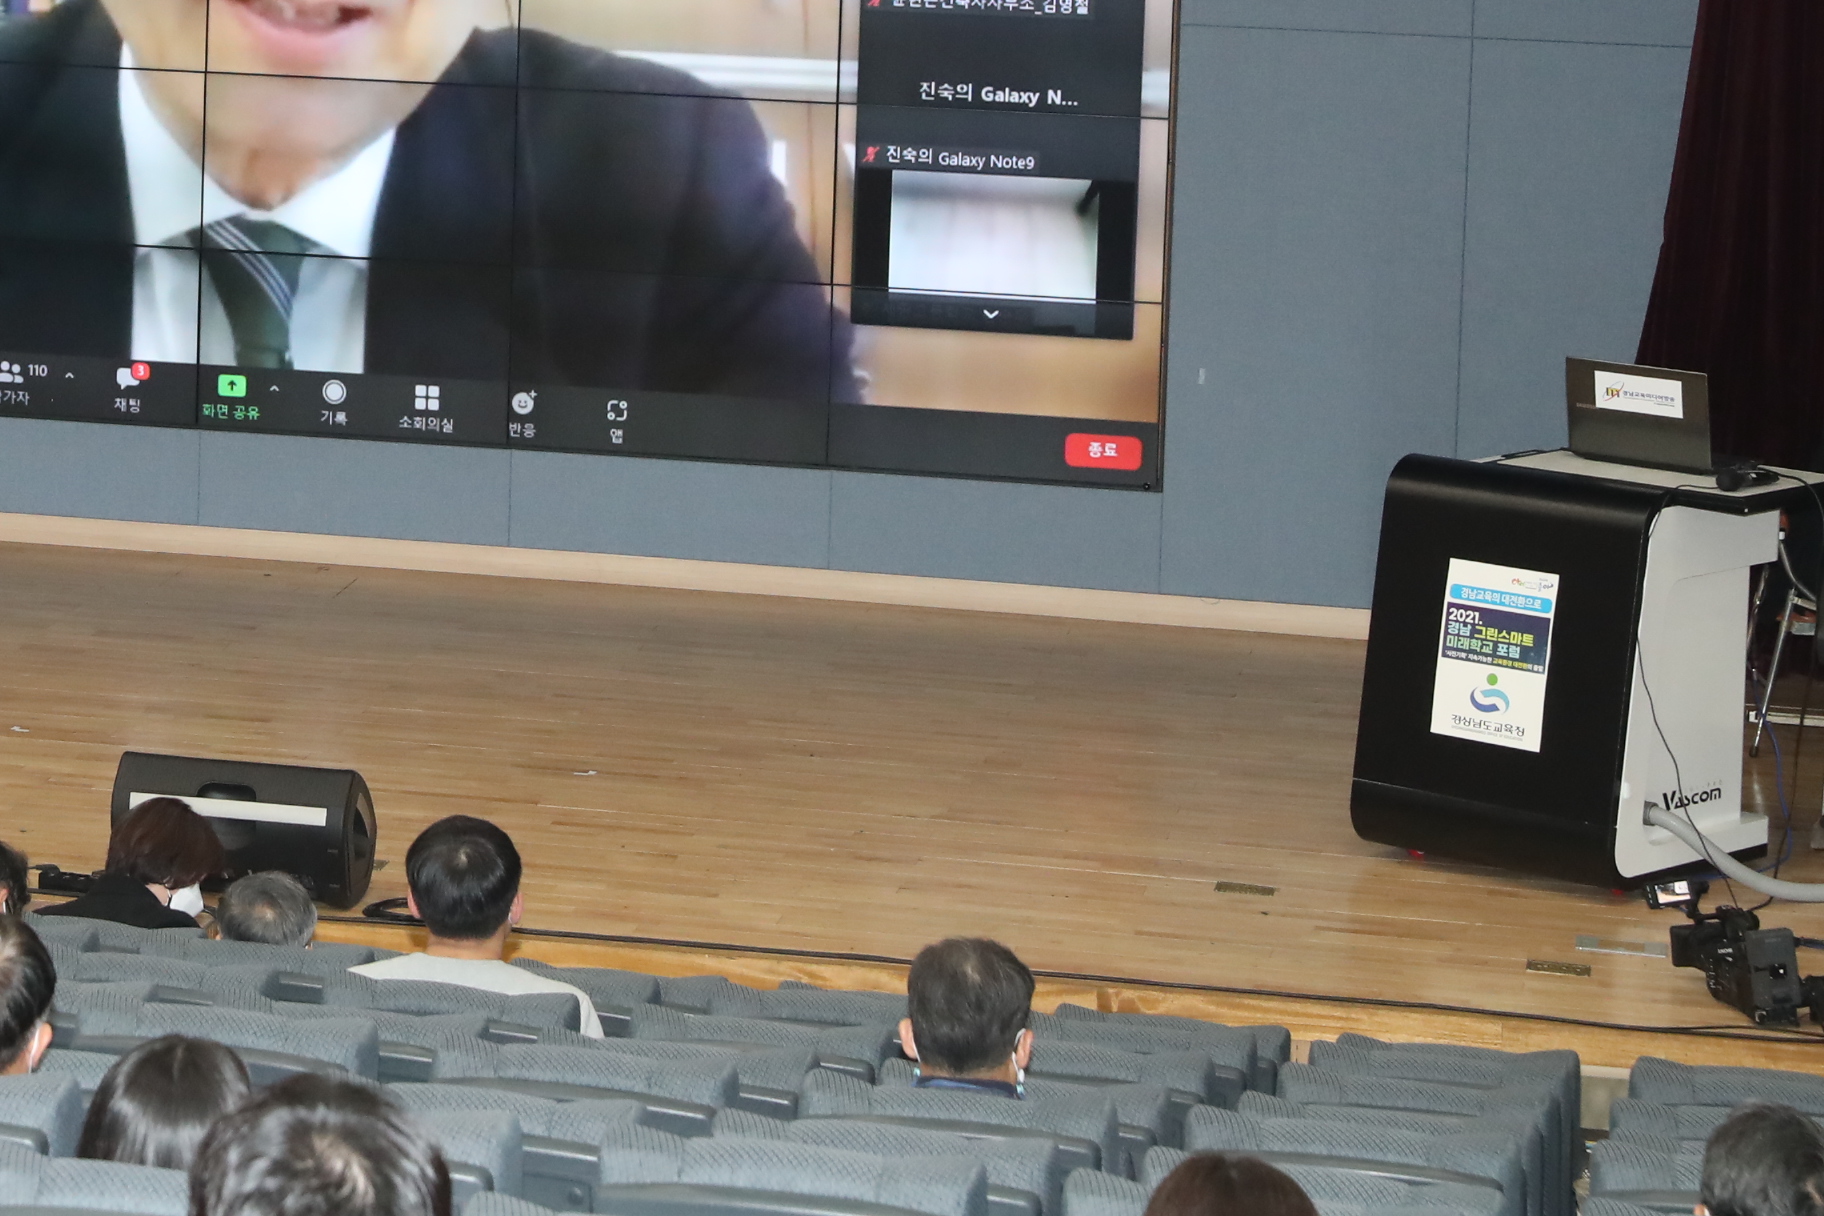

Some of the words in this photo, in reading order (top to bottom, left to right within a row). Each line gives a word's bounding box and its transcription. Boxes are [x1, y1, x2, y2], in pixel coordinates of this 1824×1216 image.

[919, 81, 973, 102] 진숙의
[980, 86, 1040, 107] Galaxy
[886, 145, 933, 164] 진숙의
[938, 151, 986, 170] Galaxy
[990, 154, 1035, 170] Note9
[27, 363, 49, 378] 110
[114, 396, 141, 413] 채팅
[202, 402, 229, 418] 화면
[232, 404, 261, 421] 공유
[320, 409, 348, 427] 기록
[398, 415, 454, 434] 소회의실
[1088, 441, 1119, 459] 종료
[1461, 587, 1501, 604] 경남교육의
[1448, 608, 1483, 625] 2021.
[1447, 621, 1472, 637] 경남
[1474, 625, 1534, 647] 그린스마트
[1446, 634, 1493, 654] 미래학교
[1496, 643, 1520, 659] 포럼
